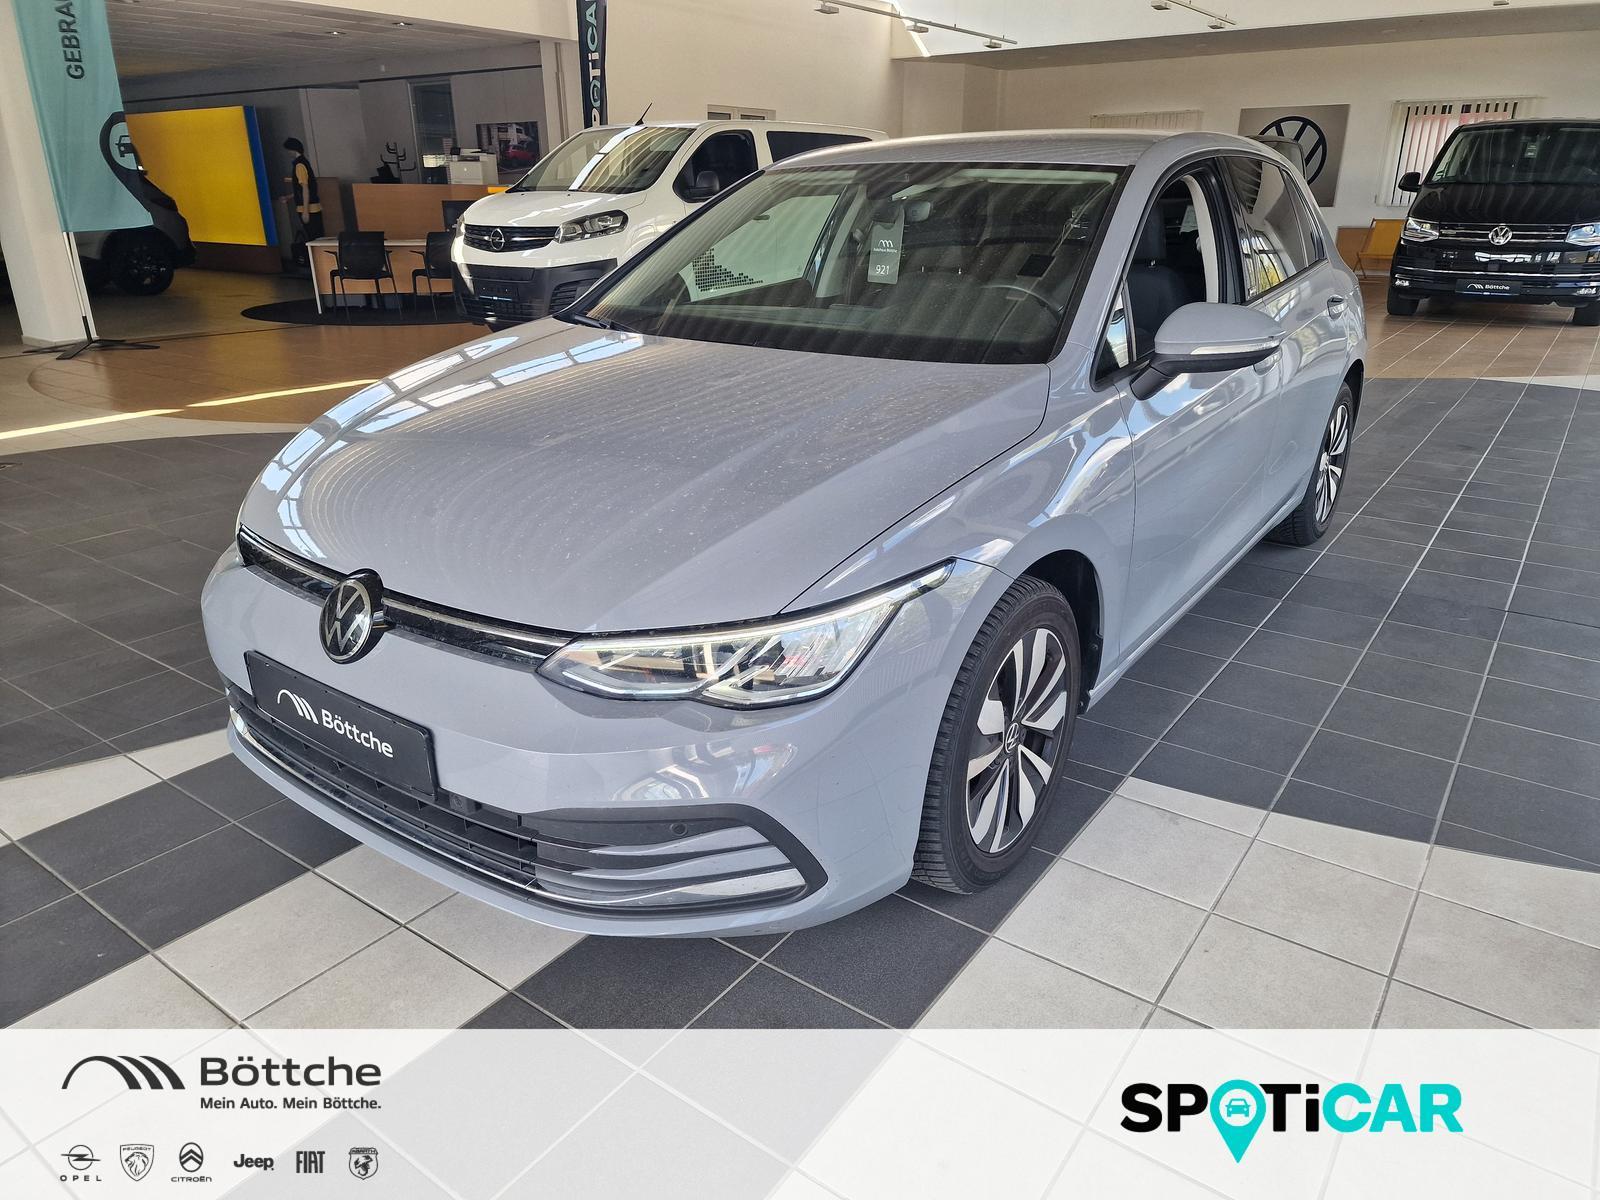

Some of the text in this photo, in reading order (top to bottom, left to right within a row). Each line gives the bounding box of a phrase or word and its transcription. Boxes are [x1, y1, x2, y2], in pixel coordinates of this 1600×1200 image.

[54, 0, 85, 79] GEBRA
[875, 264, 890, 275] 921
[321, 708, 394, 758] Böttche
